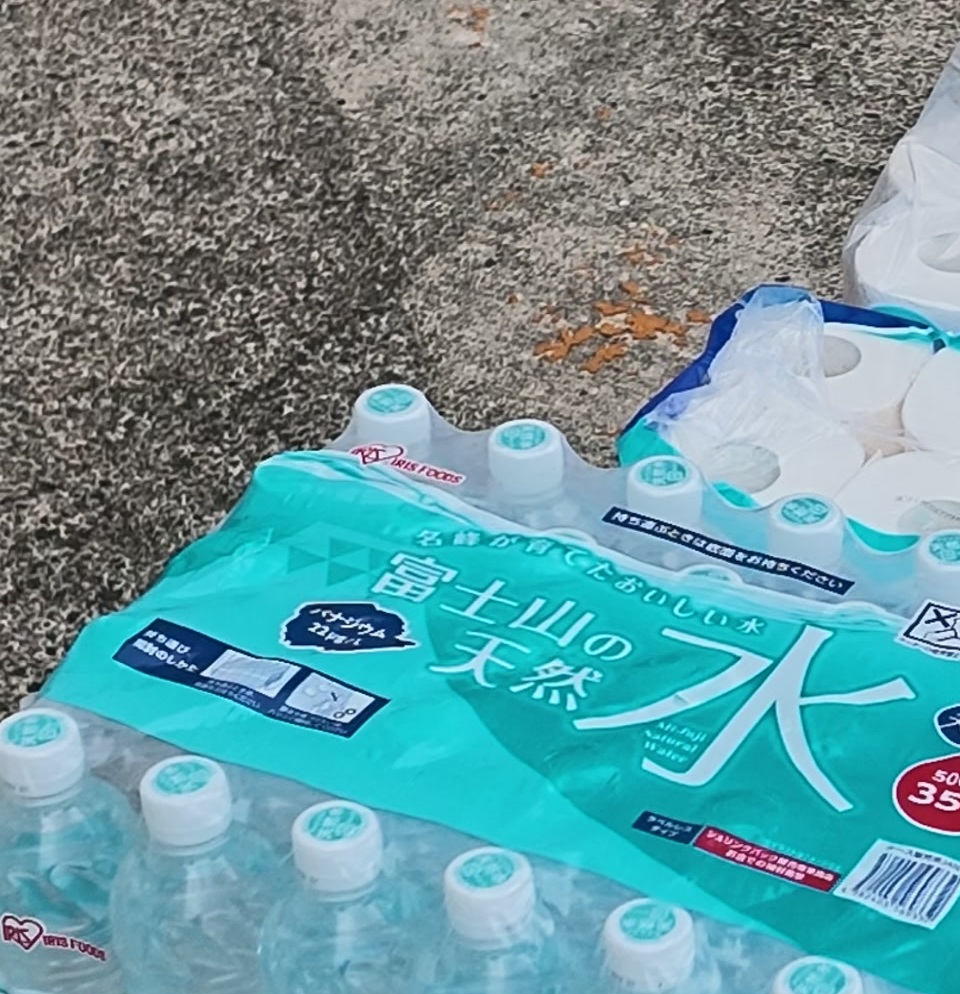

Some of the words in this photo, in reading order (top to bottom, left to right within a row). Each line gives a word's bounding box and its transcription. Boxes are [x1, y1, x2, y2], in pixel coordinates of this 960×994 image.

[308, 608, 386, 640] バナジウム
[371, 552, 634, 661] 富士山の
[416, 528, 768, 636] 名峰が育てたおいしい水
[428, 630, 604, 712] 天然
[572, 624, 918, 813] 水
